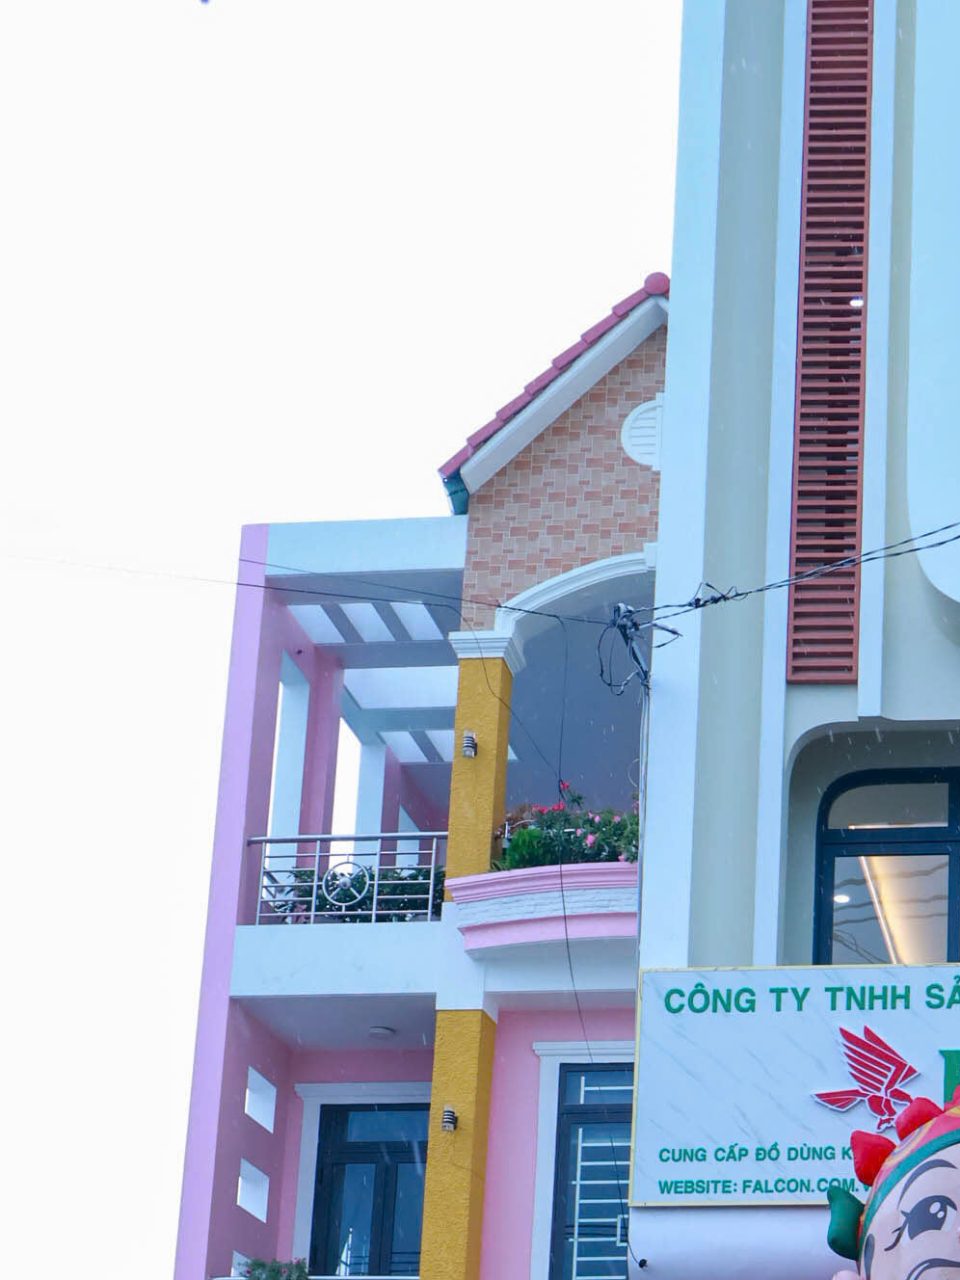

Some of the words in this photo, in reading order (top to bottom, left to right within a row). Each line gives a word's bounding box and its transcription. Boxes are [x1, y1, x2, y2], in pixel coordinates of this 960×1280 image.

[664, 983, 756, 1014] CÔNG
[770, 986, 810, 1012] TY
[825, 985, 911, 1011] TNHH
[659, 1147, 706, 1162] CUNG
[714, 1143, 749, 1162] CẤP
[787, 1143, 836, 1161] DÙNG
[658, 1179, 738, 1194] WEBSITE:
